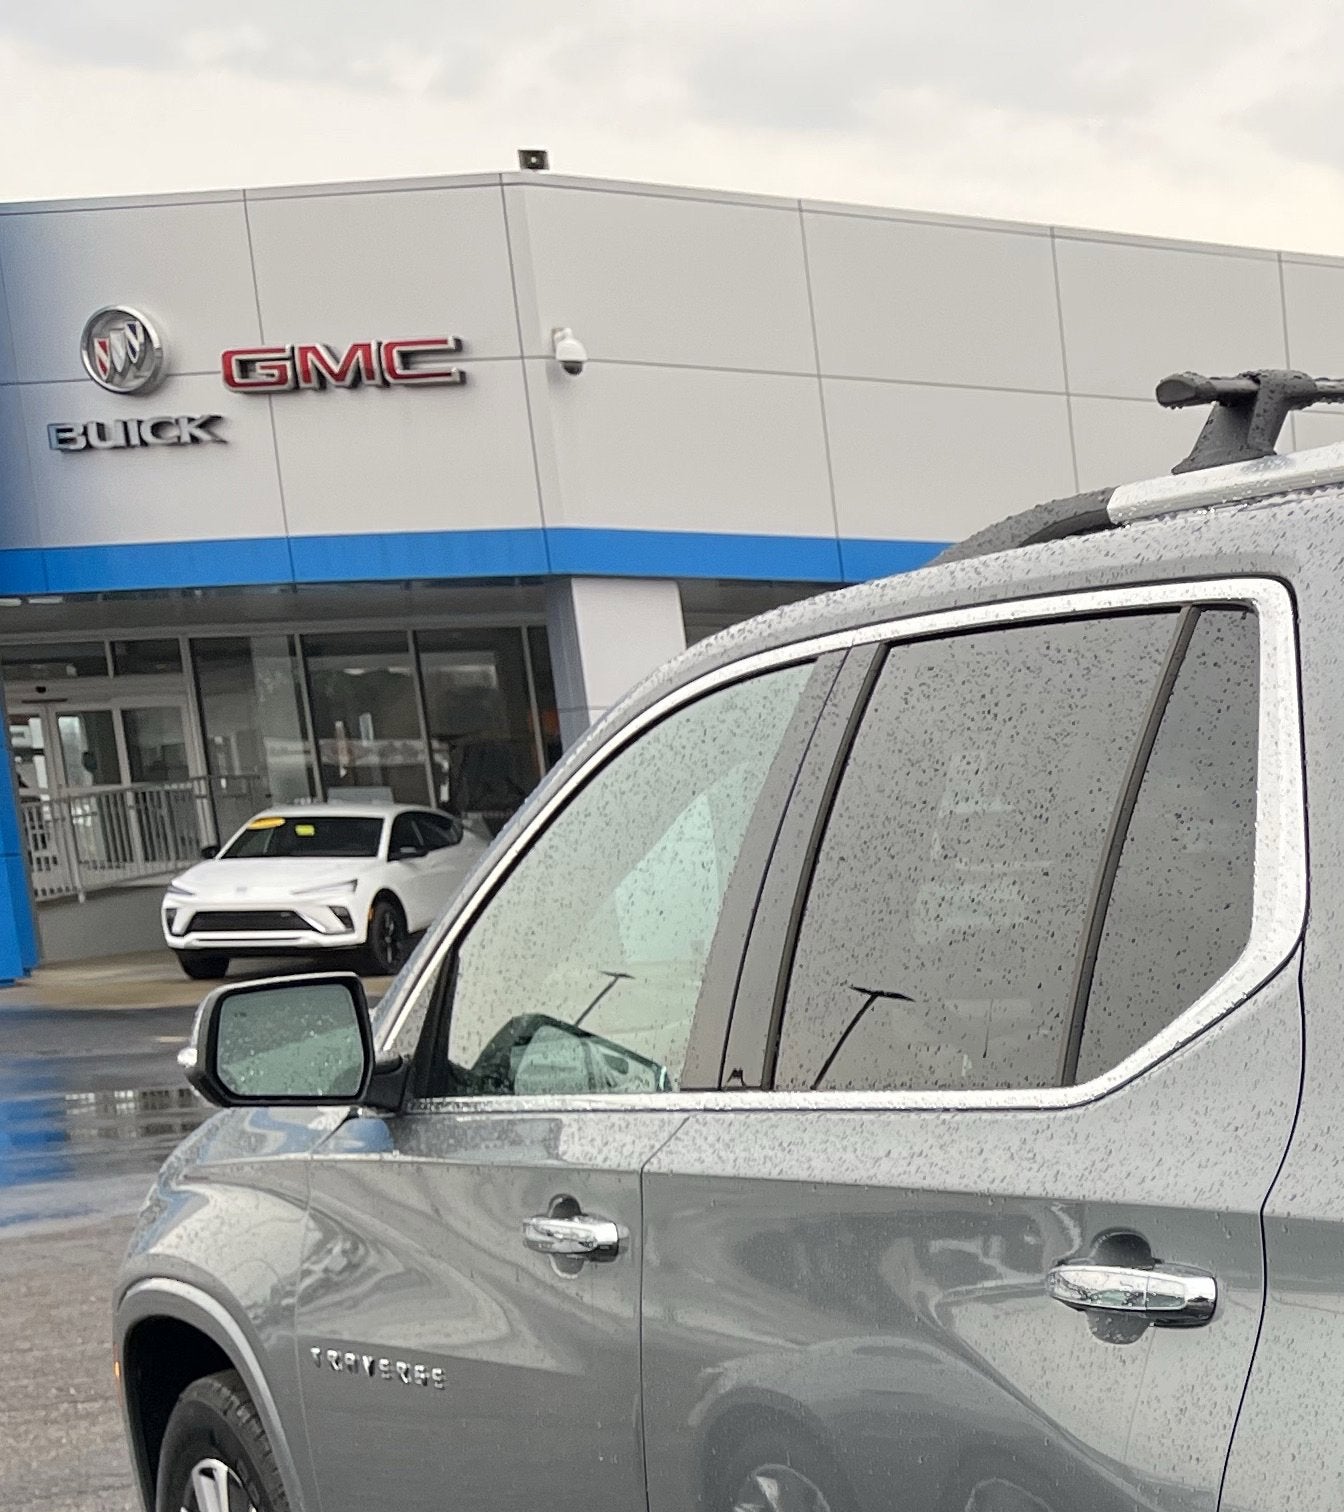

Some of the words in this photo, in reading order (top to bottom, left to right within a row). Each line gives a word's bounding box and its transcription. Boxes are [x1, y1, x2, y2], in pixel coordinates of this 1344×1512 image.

[221, 336, 466, 392] GMC
[48, 414, 228, 452] BUICK
[309, 1346, 446, 1389] TRAVERSE
